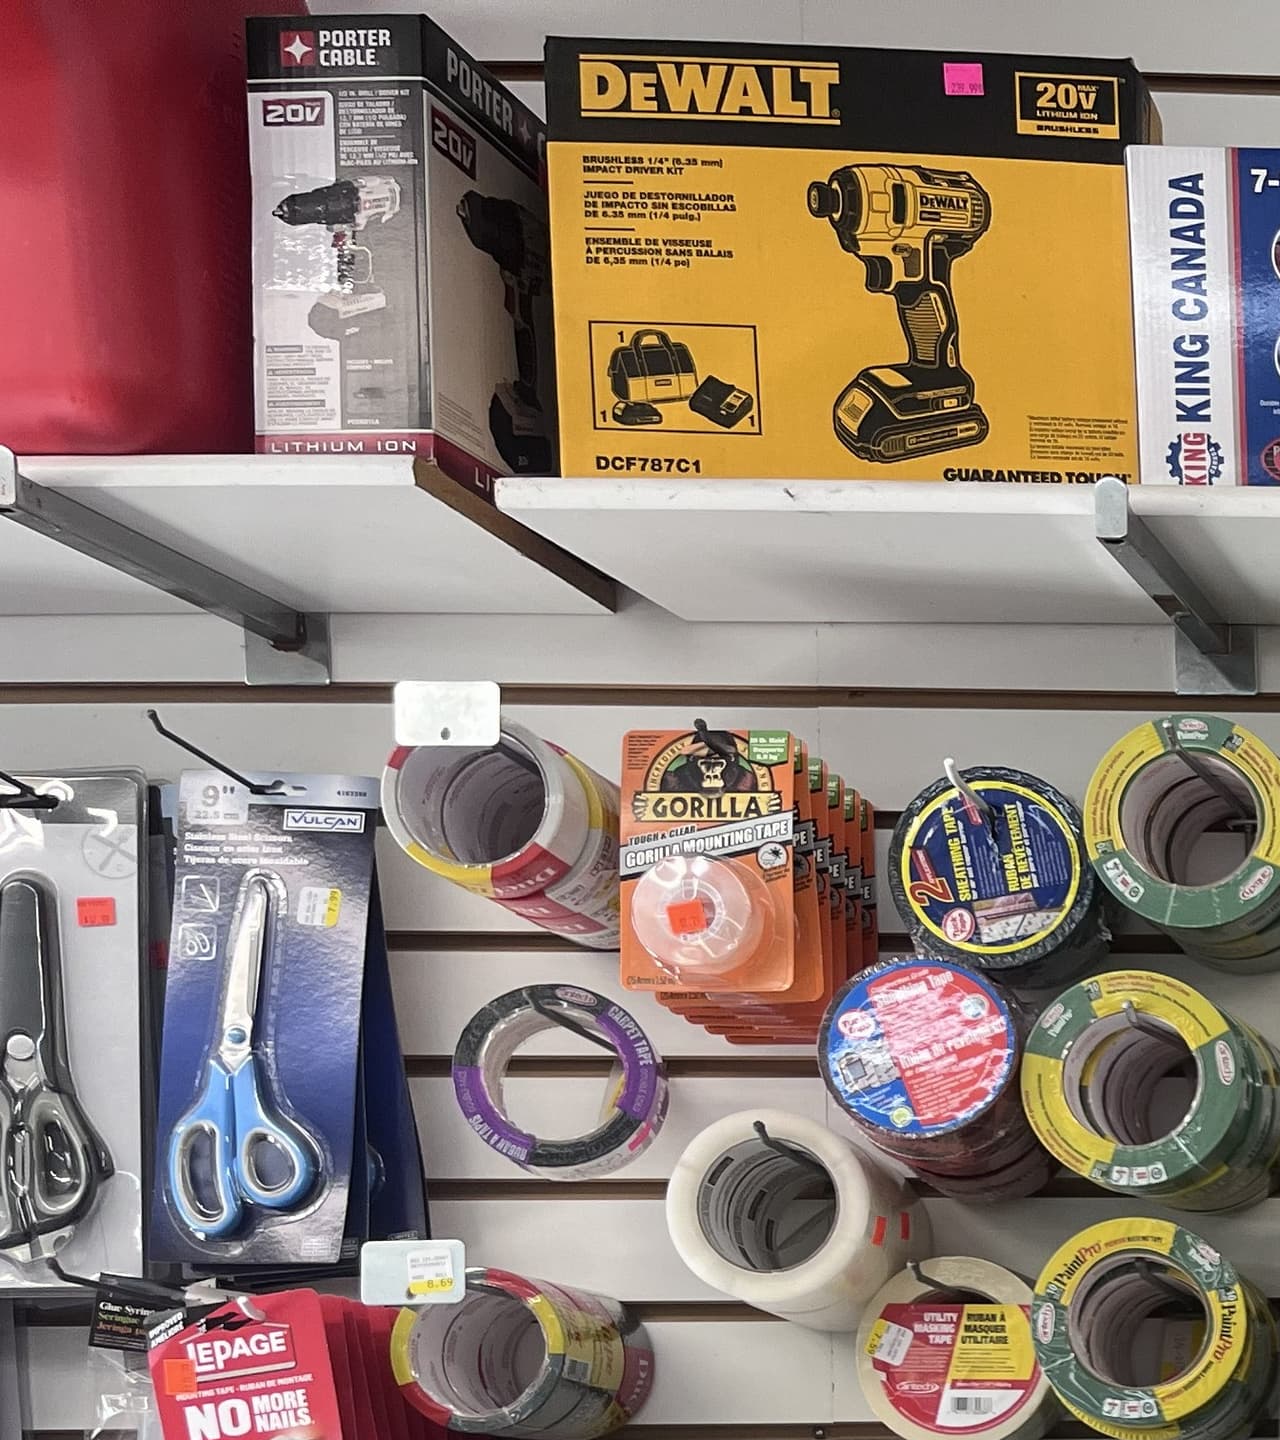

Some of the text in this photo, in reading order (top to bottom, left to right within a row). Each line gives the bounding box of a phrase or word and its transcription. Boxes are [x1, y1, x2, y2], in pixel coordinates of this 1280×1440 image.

[319, 29, 391, 47] PORTER
[320, 49, 376, 66] CABLE
[583, 155, 644, 165] BRUSHLESS
[583, 166, 684, 175] IMPACT DRIVER KIT
[1169, 173, 1212, 423] KING CANADA
[271, 440, 417, 453] LITHIUM ION
[595, 455, 702, 474] DCF787C1
[653, 797, 761, 818] GORILLA
[291, 812, 358, 827] VULCAN
[684, 821, 788, 852] MOUNTING TAPE
[427, 1277, 454, 1289] 8.69
[923, 1313, 958, 1322] UTILITY
[914, 1323, 955, 1333] MASKING
[928, 1334, 953, 1344] TAPE
[254, 1390, 308, 1411] MORE
